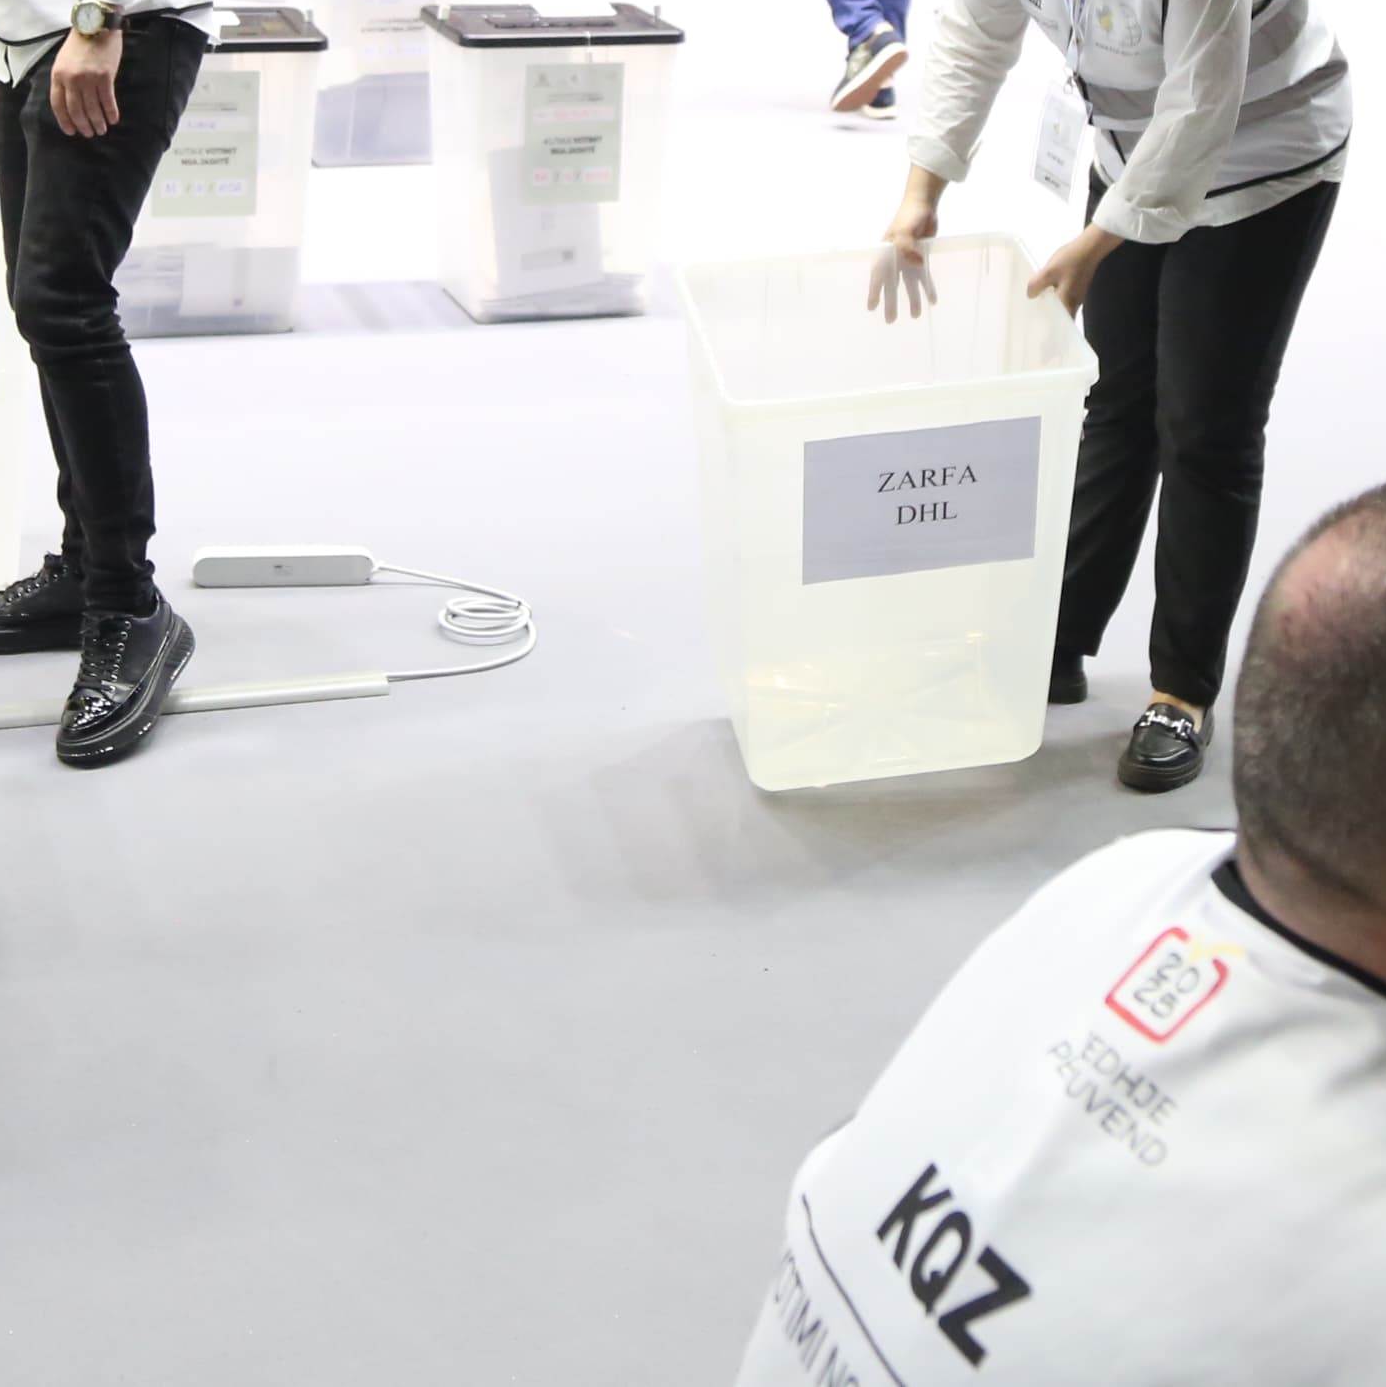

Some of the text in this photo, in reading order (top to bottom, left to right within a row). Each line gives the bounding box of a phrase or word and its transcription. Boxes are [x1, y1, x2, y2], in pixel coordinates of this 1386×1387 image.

[877, 464, 979, 494] ZARFA
[895, 501, 959, 526] DHL
[1156, 952, 1200, 994] 20
[1133, 976, 1178, 1019] 25
[875, 1161, 1033, 1370] KQZ
